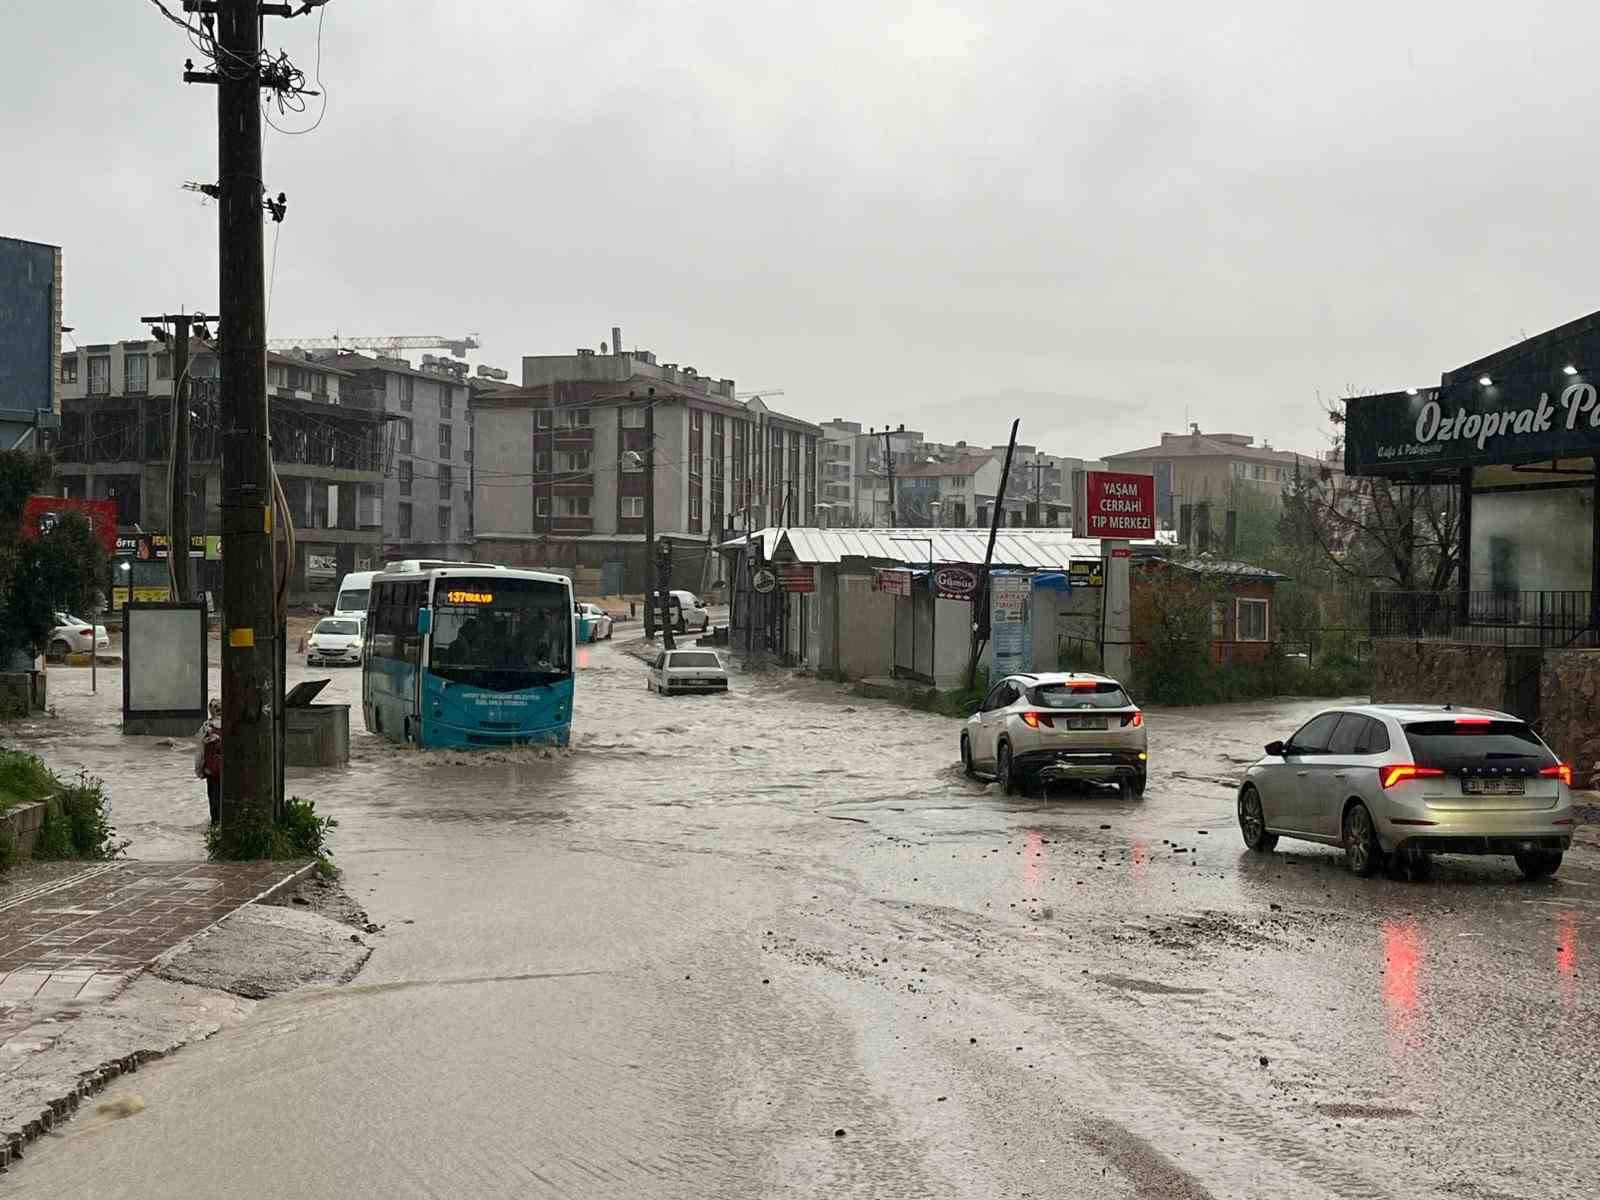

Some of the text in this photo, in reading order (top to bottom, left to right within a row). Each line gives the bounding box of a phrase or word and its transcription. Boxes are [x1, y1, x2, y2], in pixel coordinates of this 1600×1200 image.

[1416, 392, 1554, 450] Öztoprak
[1104, 482, 1138, 498] YAŞAM
[1100, 497, 1142, 512] CERRAHİ
[1091, 514, 1152, 529] TIP MERKEZİ
